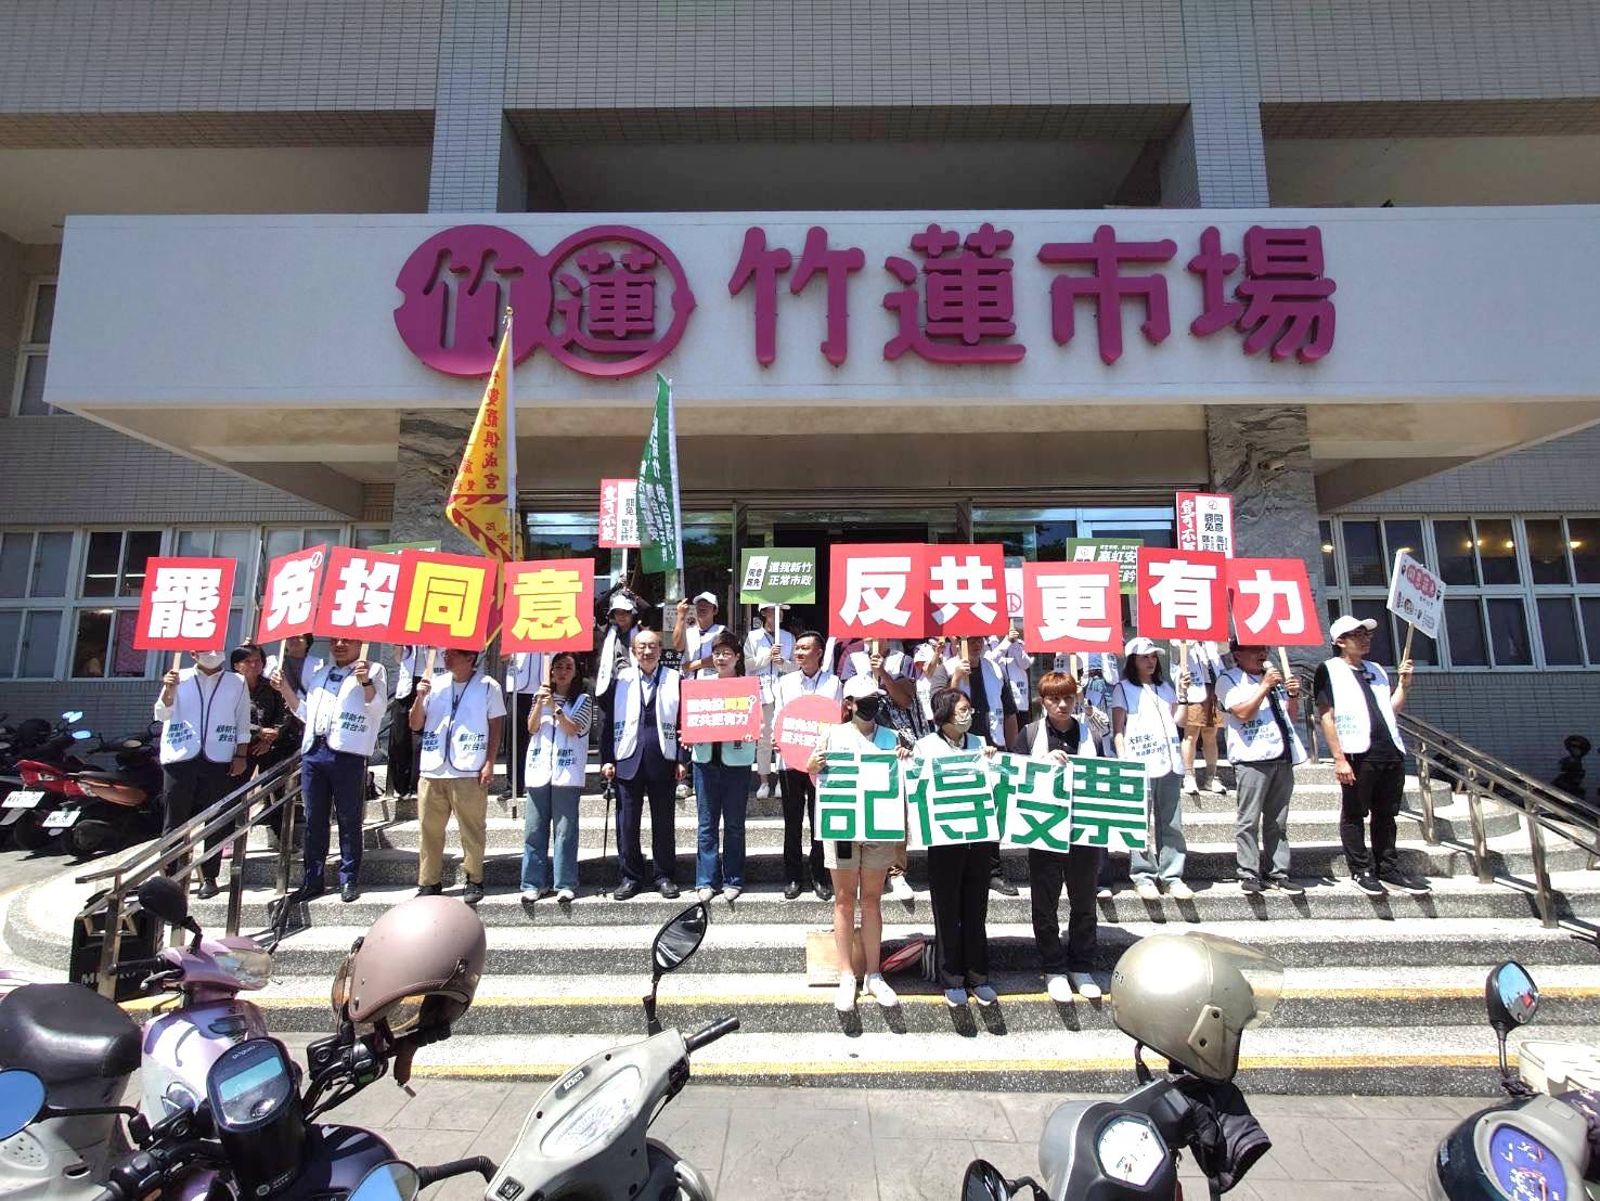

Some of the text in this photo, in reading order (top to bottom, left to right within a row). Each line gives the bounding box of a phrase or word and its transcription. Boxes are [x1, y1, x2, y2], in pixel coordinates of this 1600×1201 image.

[730, 223, 1337, 366] 竹蓮市場
[768, 575, 813, 586] 正常市政
[820, 752, 1147, 850] 記得投票
